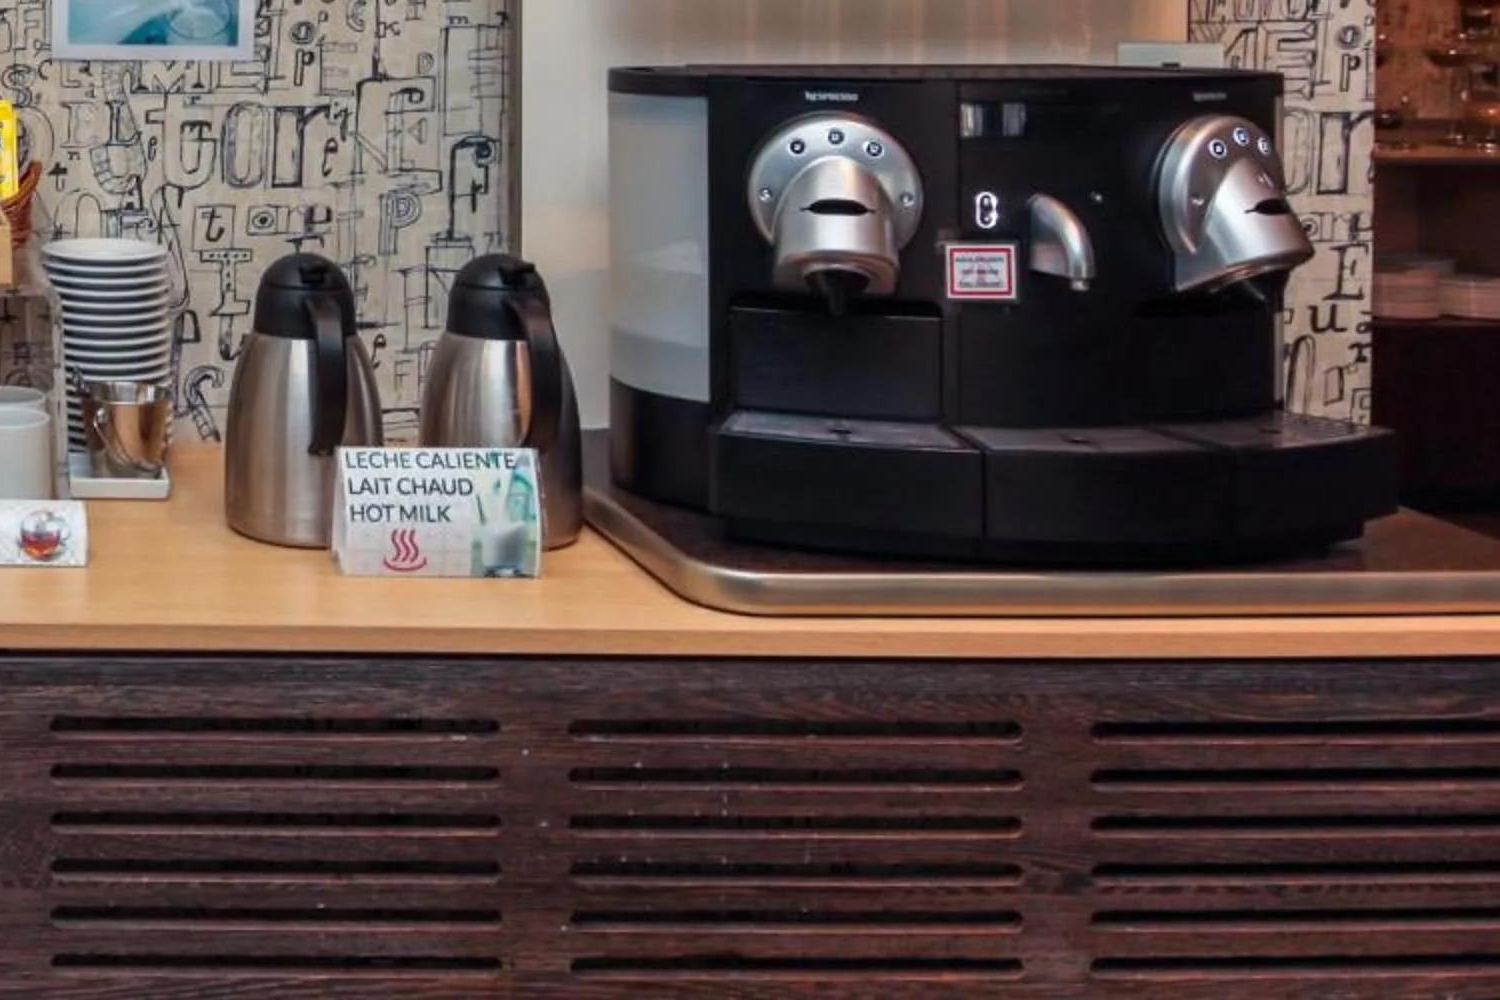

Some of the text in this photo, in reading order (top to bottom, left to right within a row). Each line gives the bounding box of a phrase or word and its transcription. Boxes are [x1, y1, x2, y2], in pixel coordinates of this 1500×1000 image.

[345, 451, 516, 469] LECHE CALIENTE
[348, 477, 473, 496] LAIT CHAUD
[350, 504, 451, 523] HOT MILK
